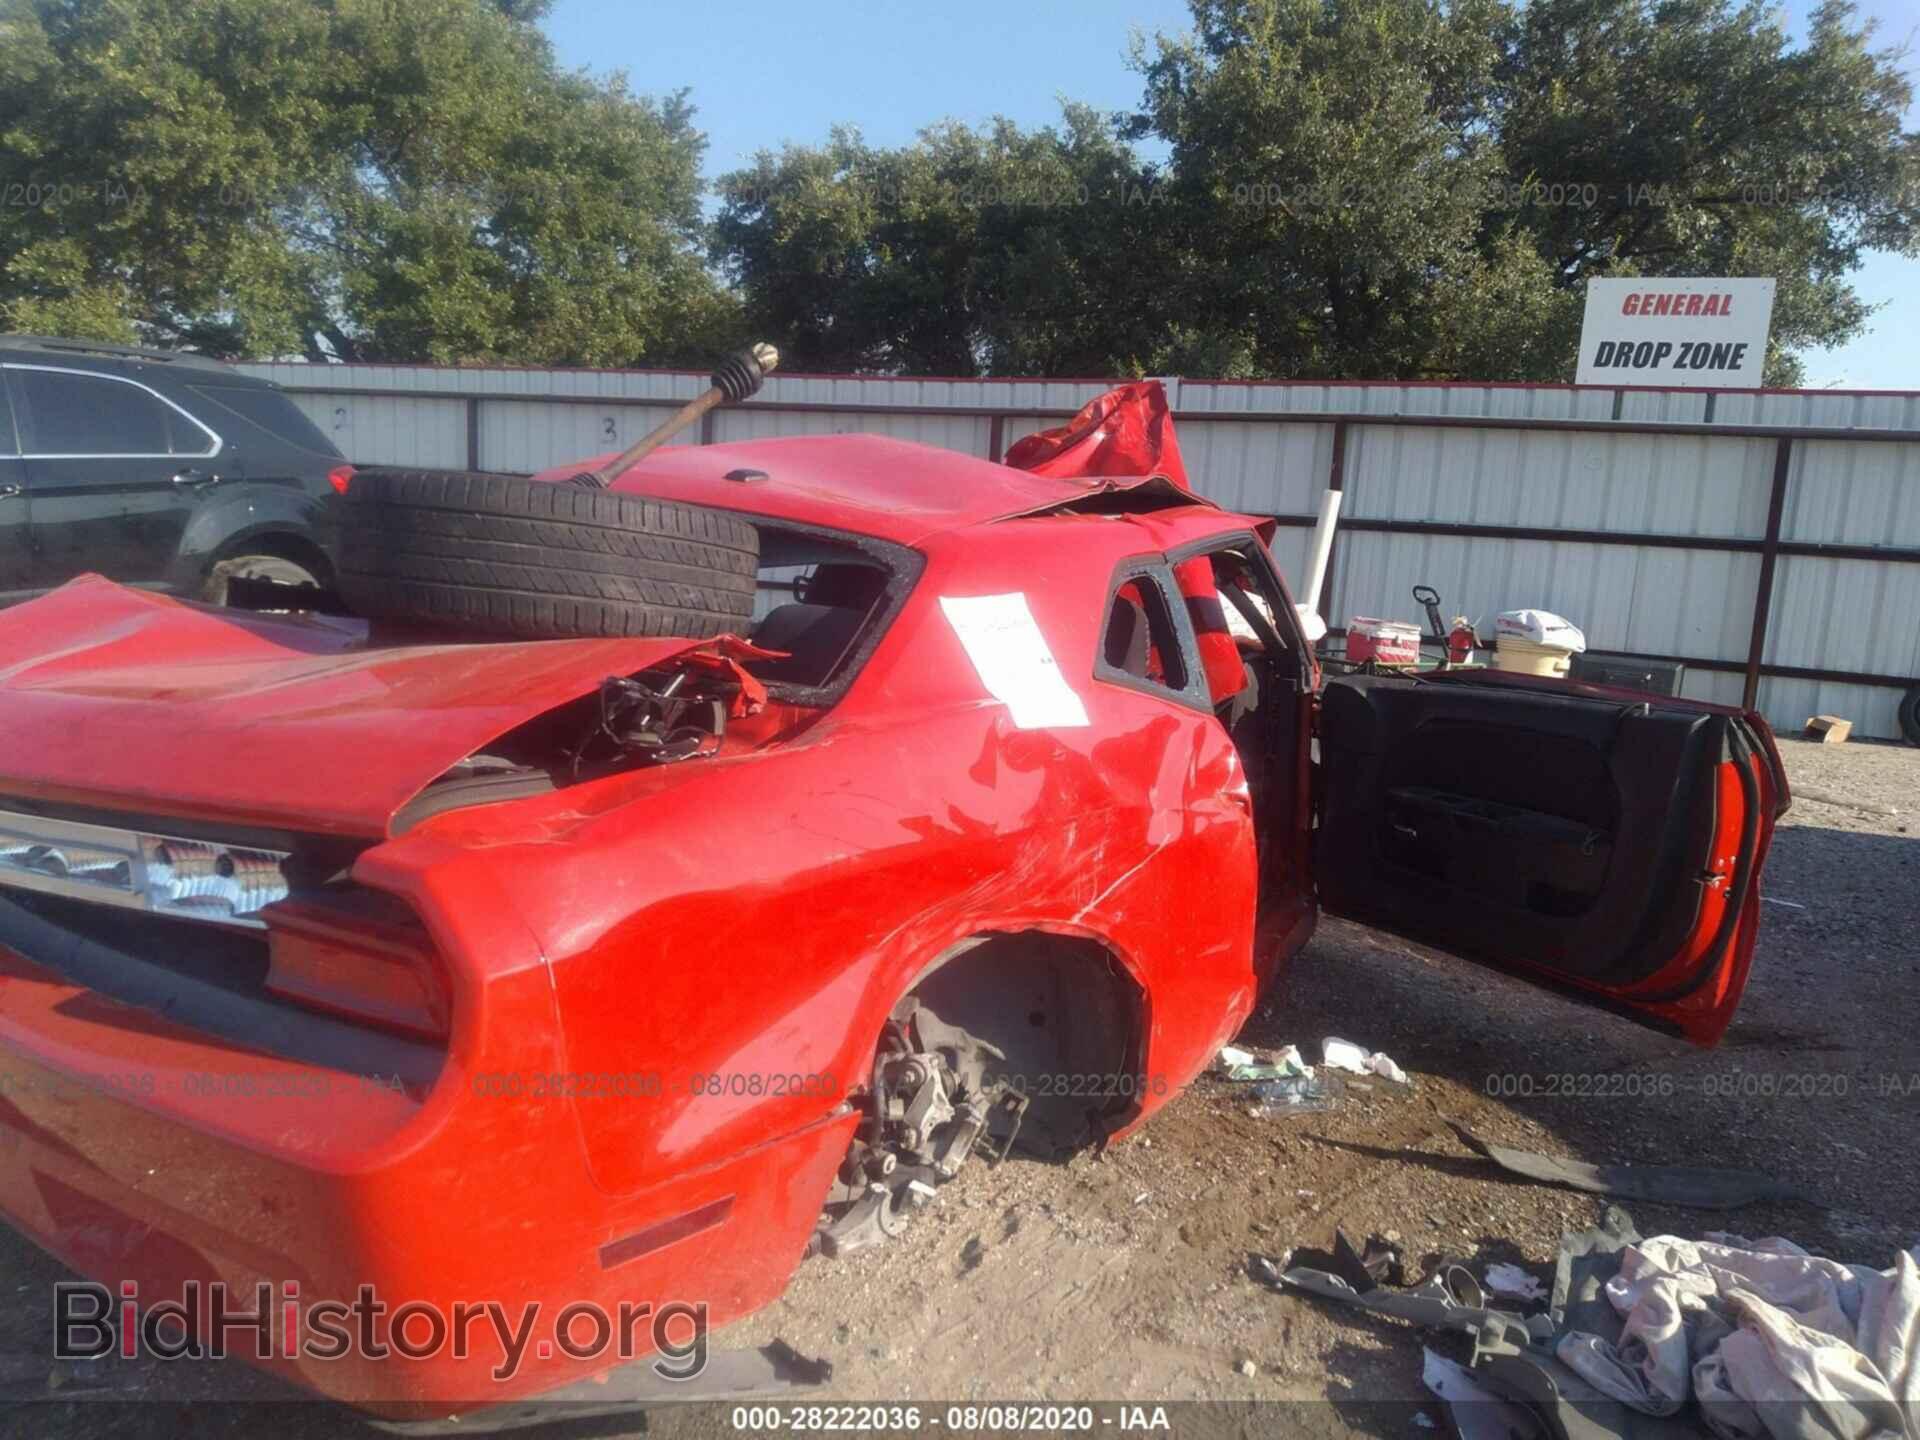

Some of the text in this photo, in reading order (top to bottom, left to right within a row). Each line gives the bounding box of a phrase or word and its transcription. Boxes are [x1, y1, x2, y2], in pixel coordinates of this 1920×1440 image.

[1622, 293, 1733, 316] GENERAL
[1593, 341, 1748, 370] DROP ZONE
[601, 416, 617, 443] 3
